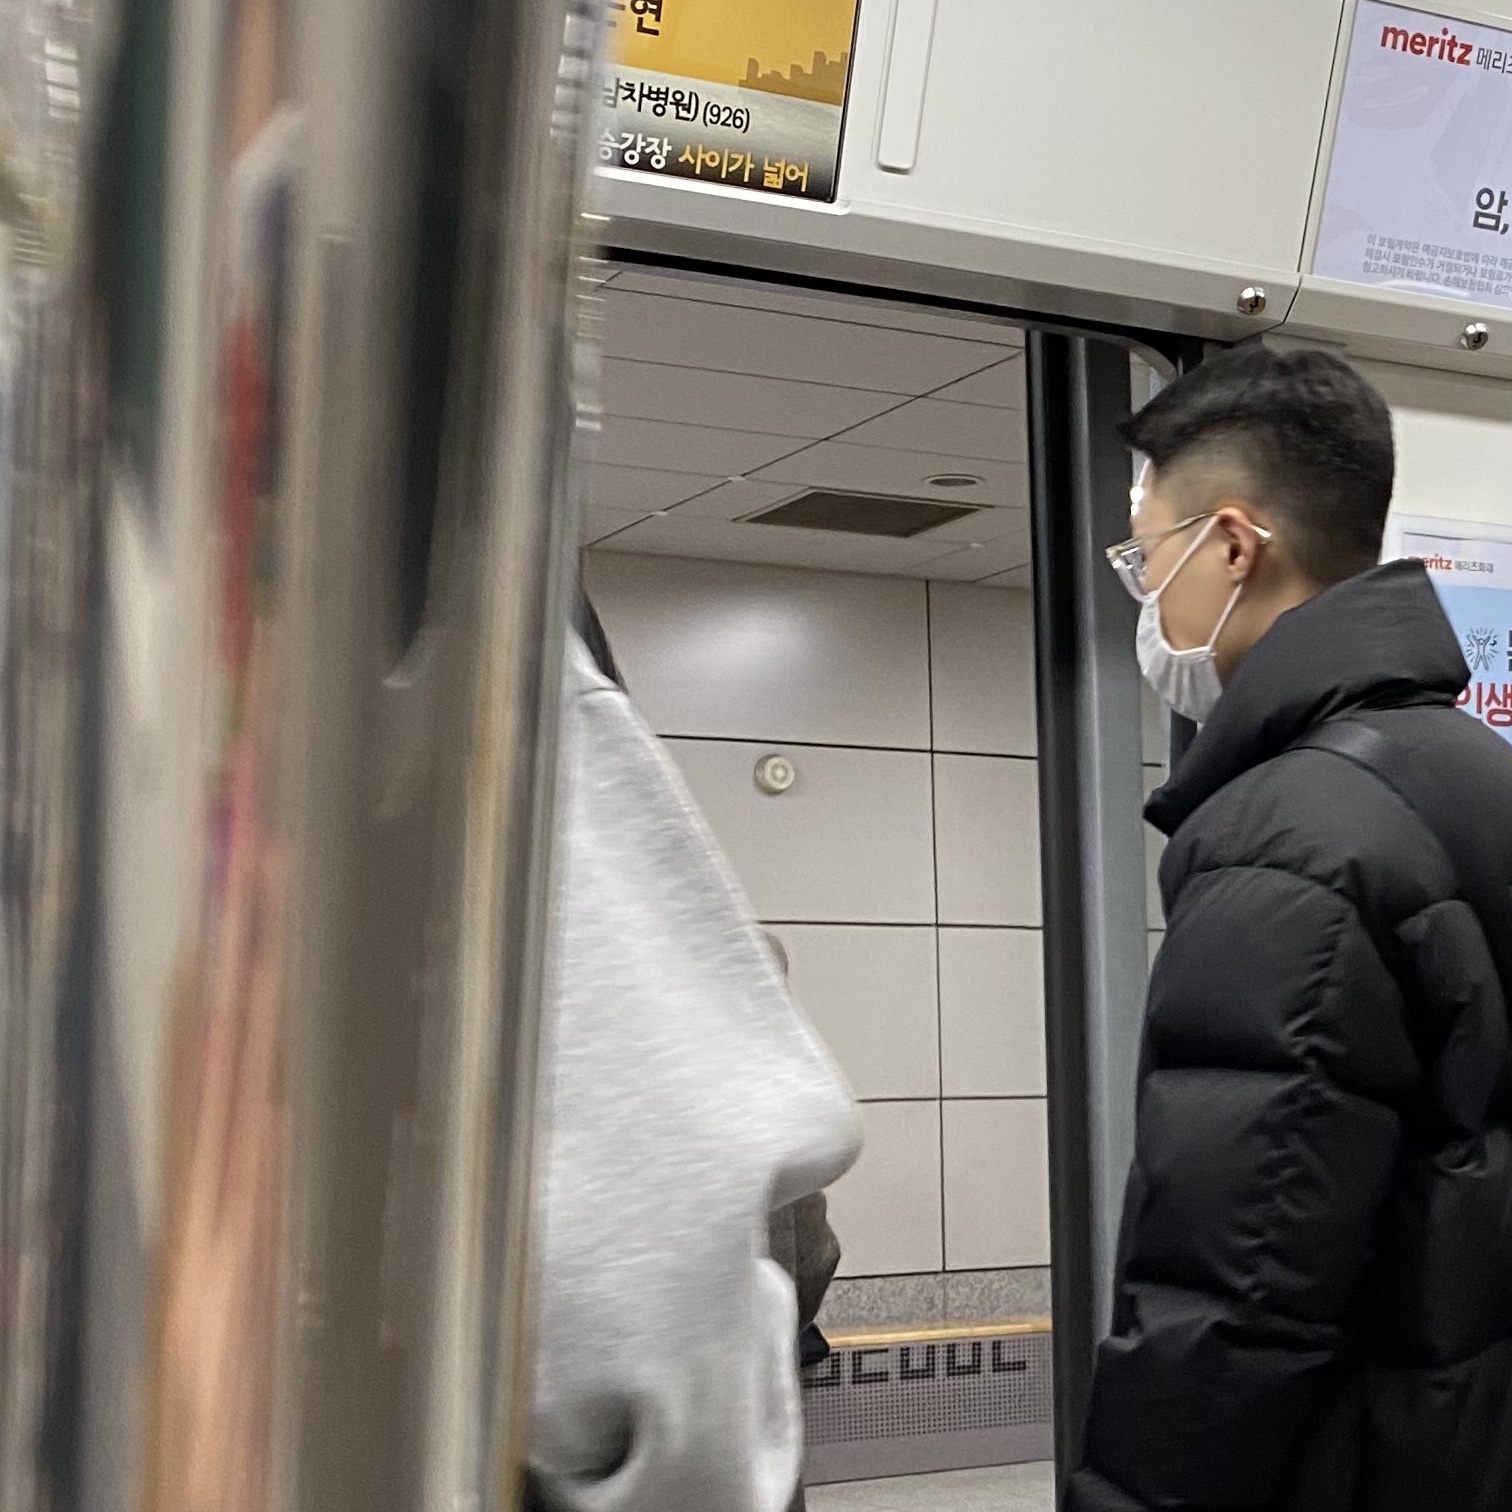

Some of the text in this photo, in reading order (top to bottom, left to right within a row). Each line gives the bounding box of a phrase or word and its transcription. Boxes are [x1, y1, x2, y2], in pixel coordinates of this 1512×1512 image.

[1380, 25, 1474, 66] meritz
[703, 101, 750, 133] (926)
[597, 127, 810, 192] 승강장 사이가 넓어
[1472, 187, 1509, 235] 암,
